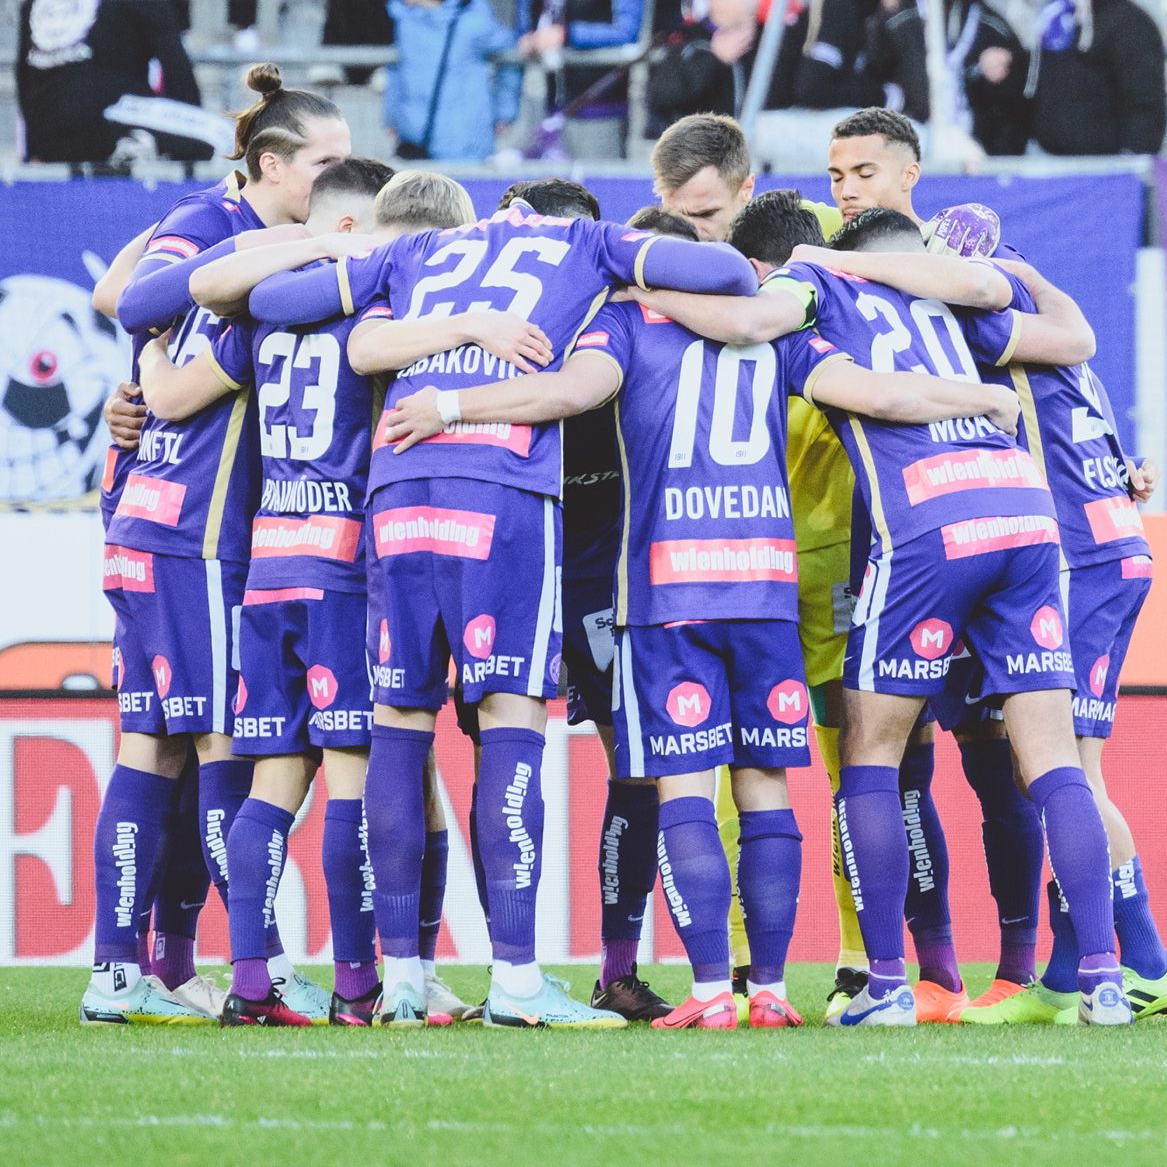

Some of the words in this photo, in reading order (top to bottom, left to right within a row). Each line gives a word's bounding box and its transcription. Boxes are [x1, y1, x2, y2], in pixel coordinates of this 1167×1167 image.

[403, 236, 571, 323] 25
[856, 291, 981, 384] 20
[259, 332, 340, 461] 23
[668, 340, 777, 468] 10
[665, 485, 790, 521] DOVEDAN
[920, 628, 944, 649] M
[311, 676, 329, 698] M
[676, 692, 700, 716] M
[778, 690, 802, 713] M
[649, 722, 733, 756] MARSBET
[501, 761, 535, 890] wienholding
[112, 821, 139, 928] wienholding
